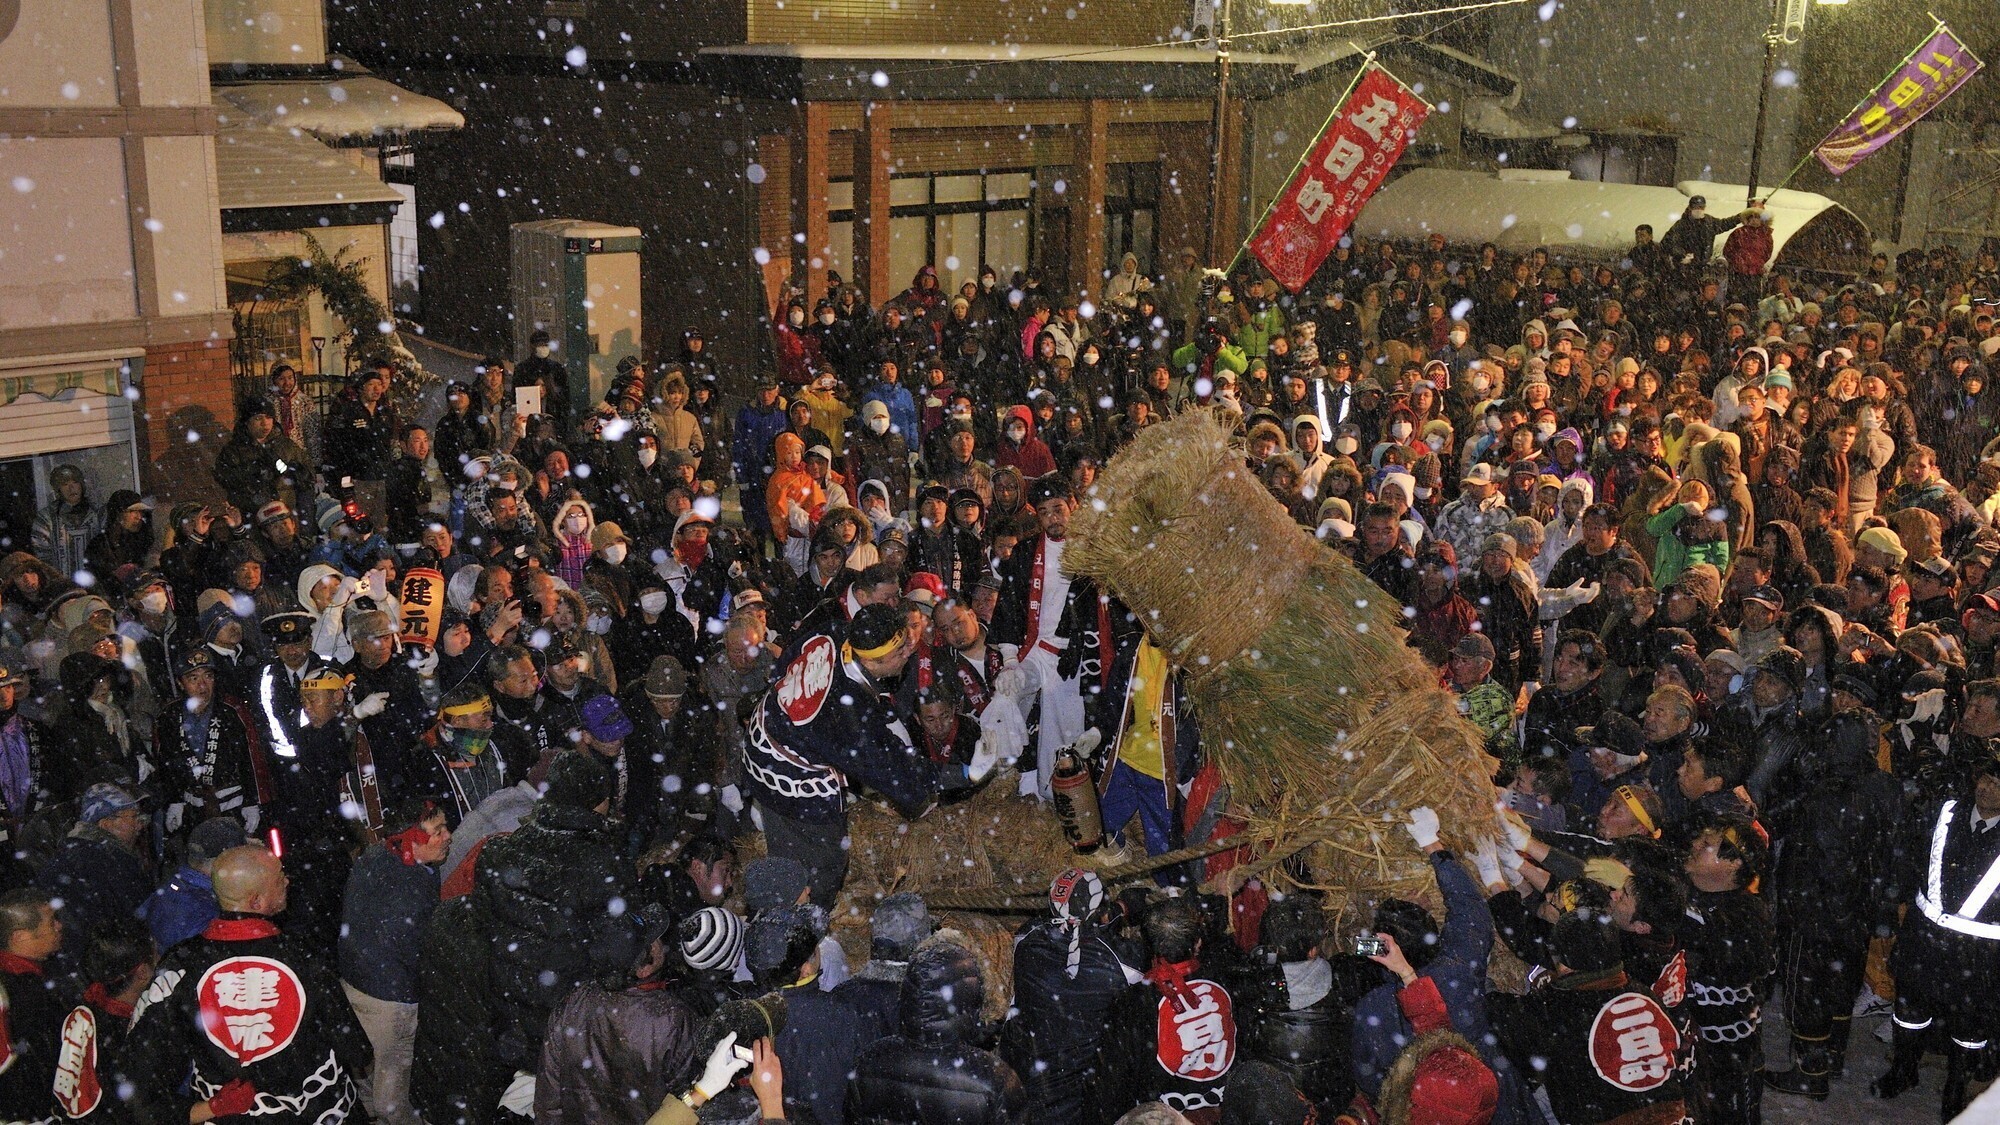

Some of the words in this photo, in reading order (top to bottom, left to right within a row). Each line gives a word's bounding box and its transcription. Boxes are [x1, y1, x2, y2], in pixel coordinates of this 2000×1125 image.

[1860, 52, 1953, 136] 二日町
[1296, 93, 1398, 224] 五日町
[401, 577, 432, 637] 建元
[203, 716, 222, 786] 大仙市消防団
[213, 967, 281, 1051] 建元
[1610, 997, 1669, 1084] 二日町
